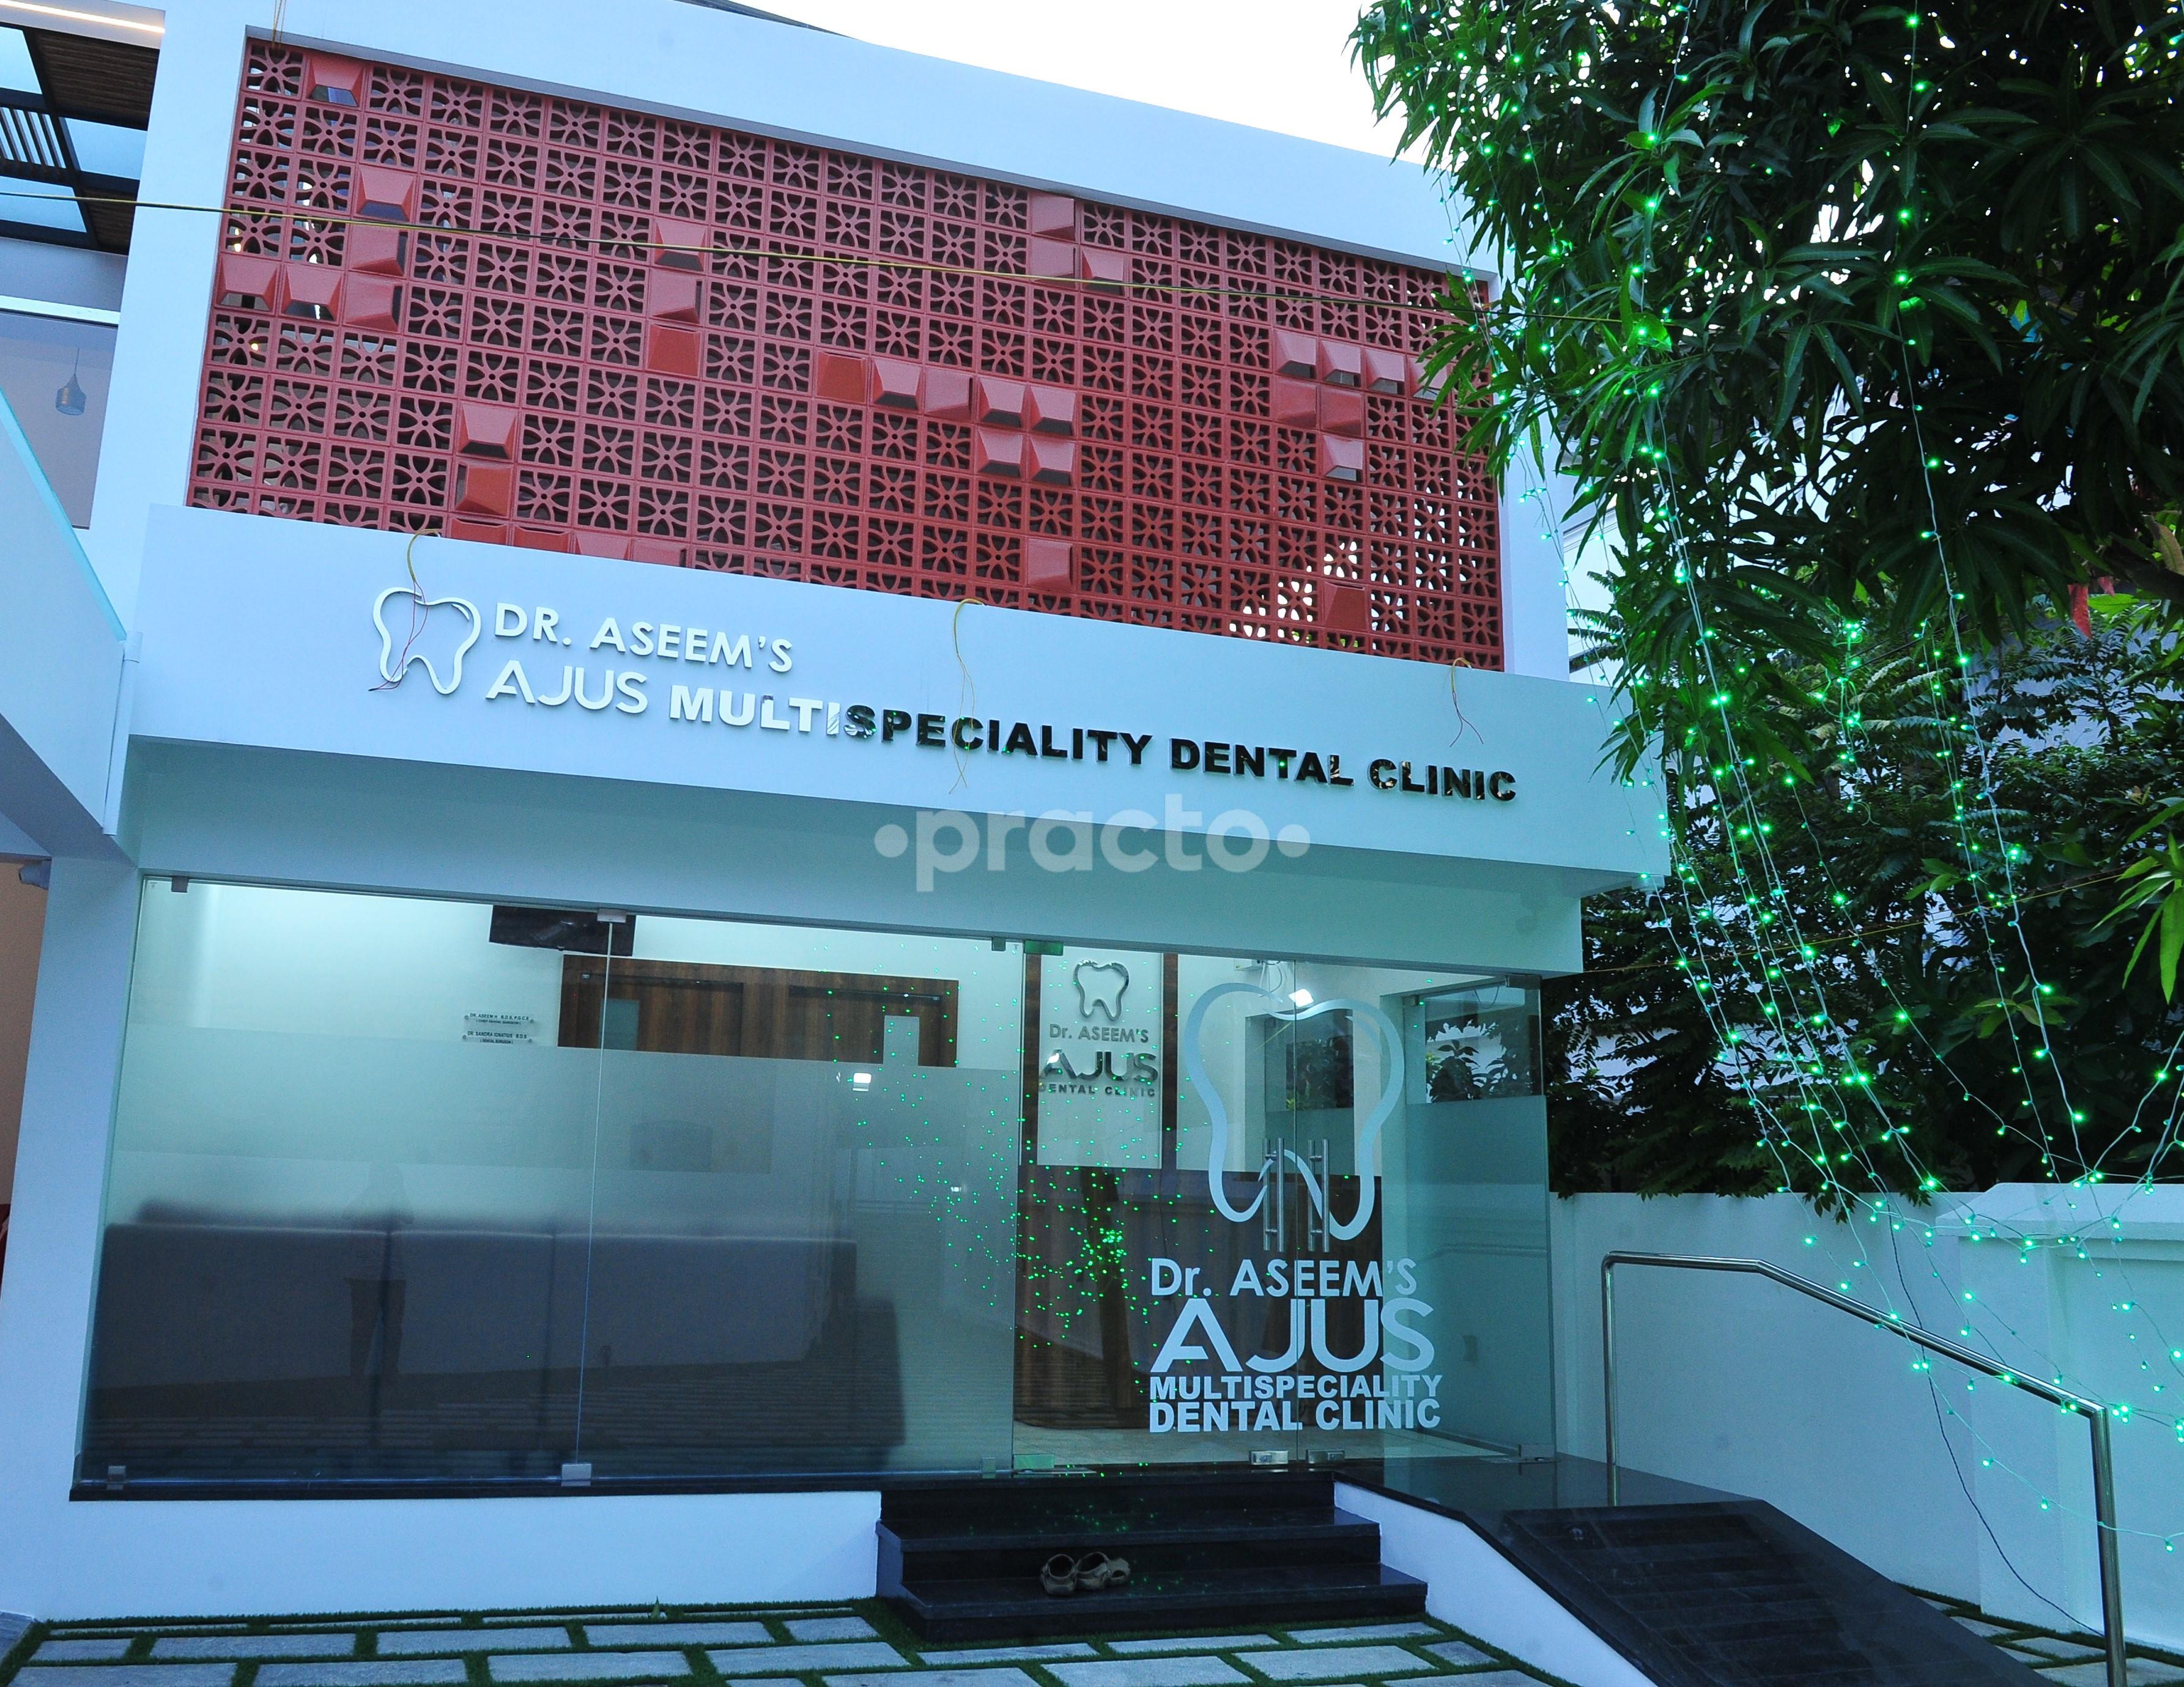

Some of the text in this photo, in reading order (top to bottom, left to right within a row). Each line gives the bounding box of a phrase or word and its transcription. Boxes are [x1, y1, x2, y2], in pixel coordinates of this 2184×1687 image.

[494, 602, 793, 673] DR. ASEEM'S
[485, 660, 1517, 802] AJUS MULTISPECIALITY DENTAL CLINIC
[1049, 1024, 1149, 1043] Dr. ASEEM'S
[1040, 1049, 1158, 1082] AJUS
[1040, 1083, 1095, 1095] DENTAL
[1151, 1258, 1417, 1297] Dr. ASEEM'S
[1150, 1298, 1435, 1373] AJUS
[1150, 1375, 1442, 1400] MULTISPECIALITY
[1149, 1398, 1441, 1433] DENTAL CLINIC
